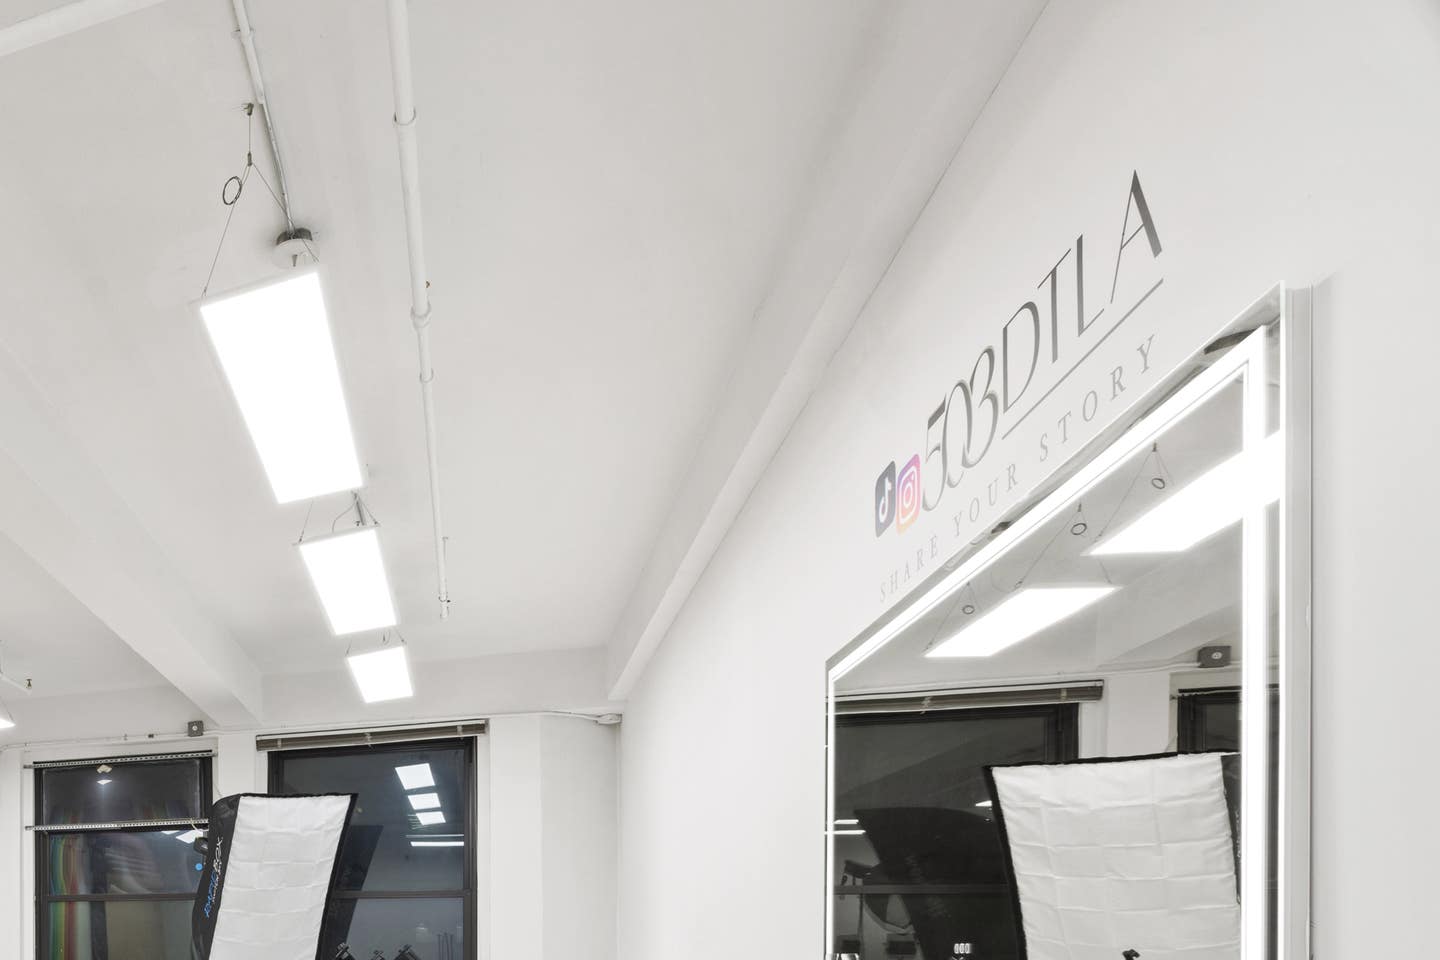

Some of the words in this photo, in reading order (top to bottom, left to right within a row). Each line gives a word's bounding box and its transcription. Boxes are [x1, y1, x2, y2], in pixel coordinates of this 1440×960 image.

[879, 535, 939, 603] SHARE
[953, 463, 1018, 537] YOUR
[1039, 334, 1157, 462] STORY
[922, 169, 1163, 512] 503DTLA
